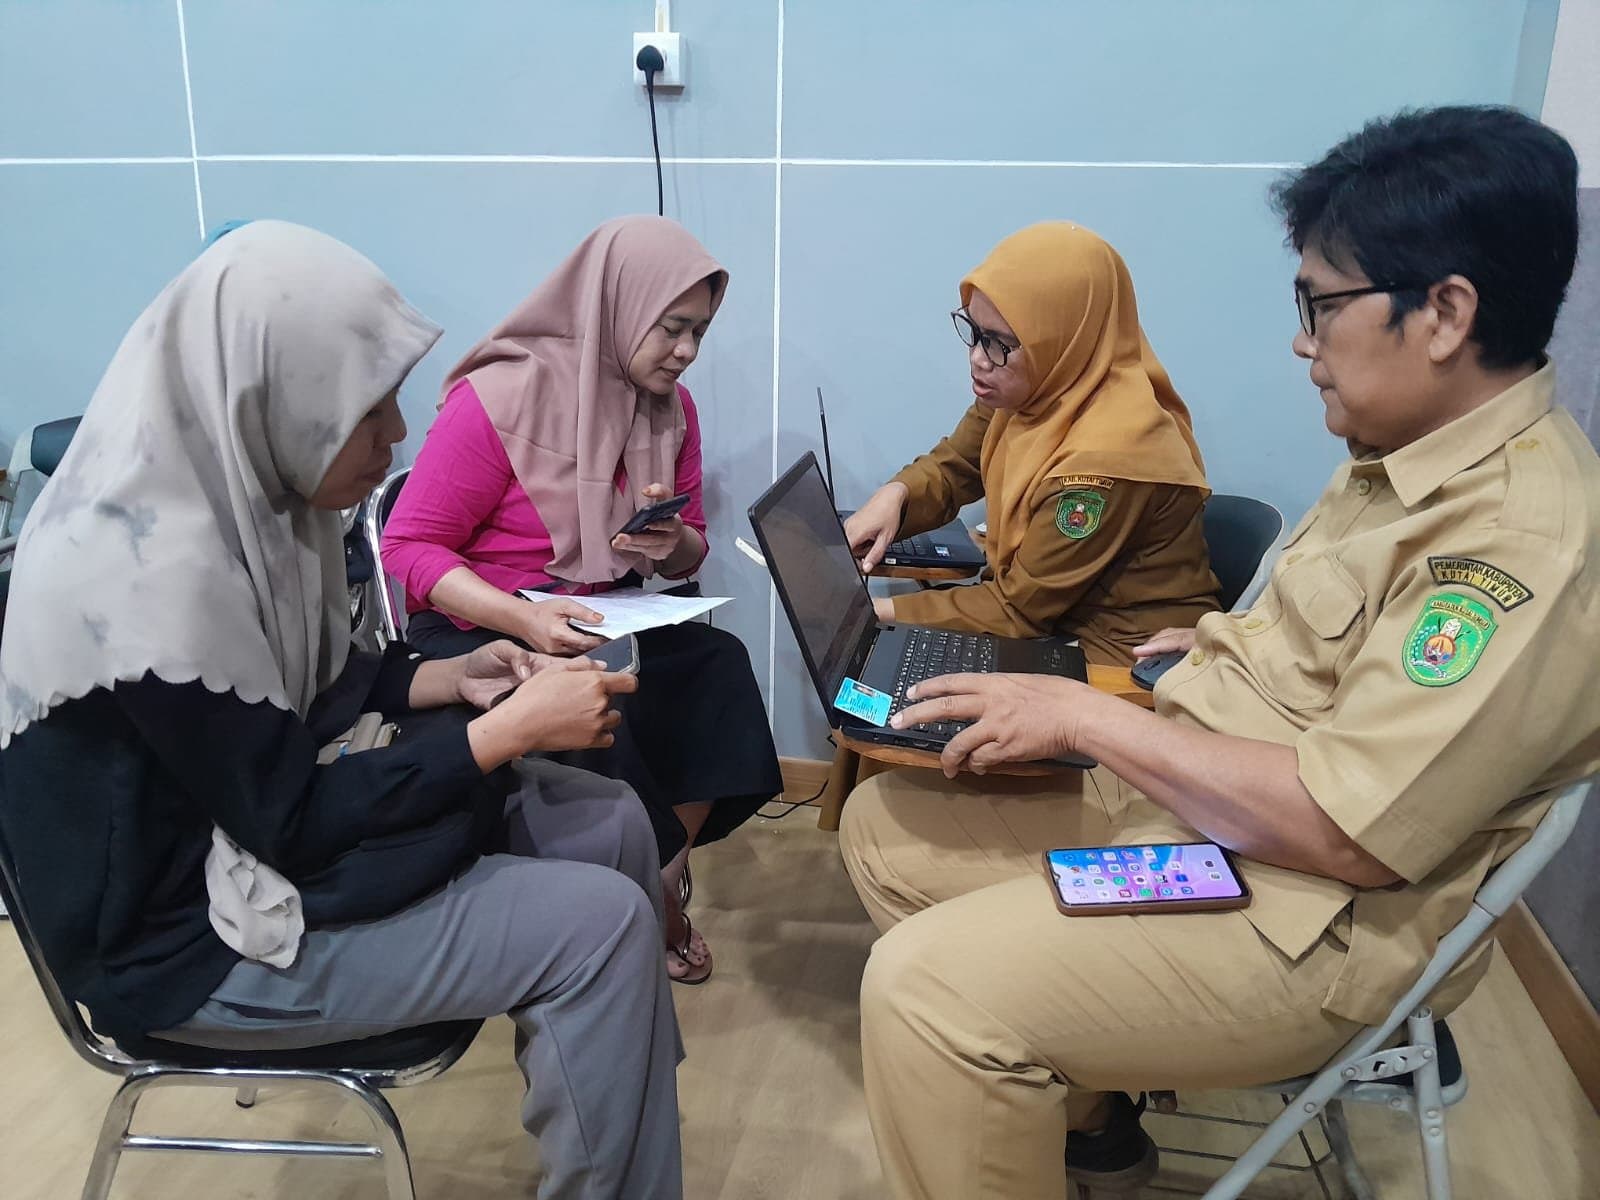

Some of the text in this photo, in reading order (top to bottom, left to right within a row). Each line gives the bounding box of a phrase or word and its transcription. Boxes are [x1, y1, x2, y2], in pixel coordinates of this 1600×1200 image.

[1434, 561, 1525, 599] PEMERINTAH KABUPATEN
[1442, 570, 1512, 603] KUTAI TIMUR
